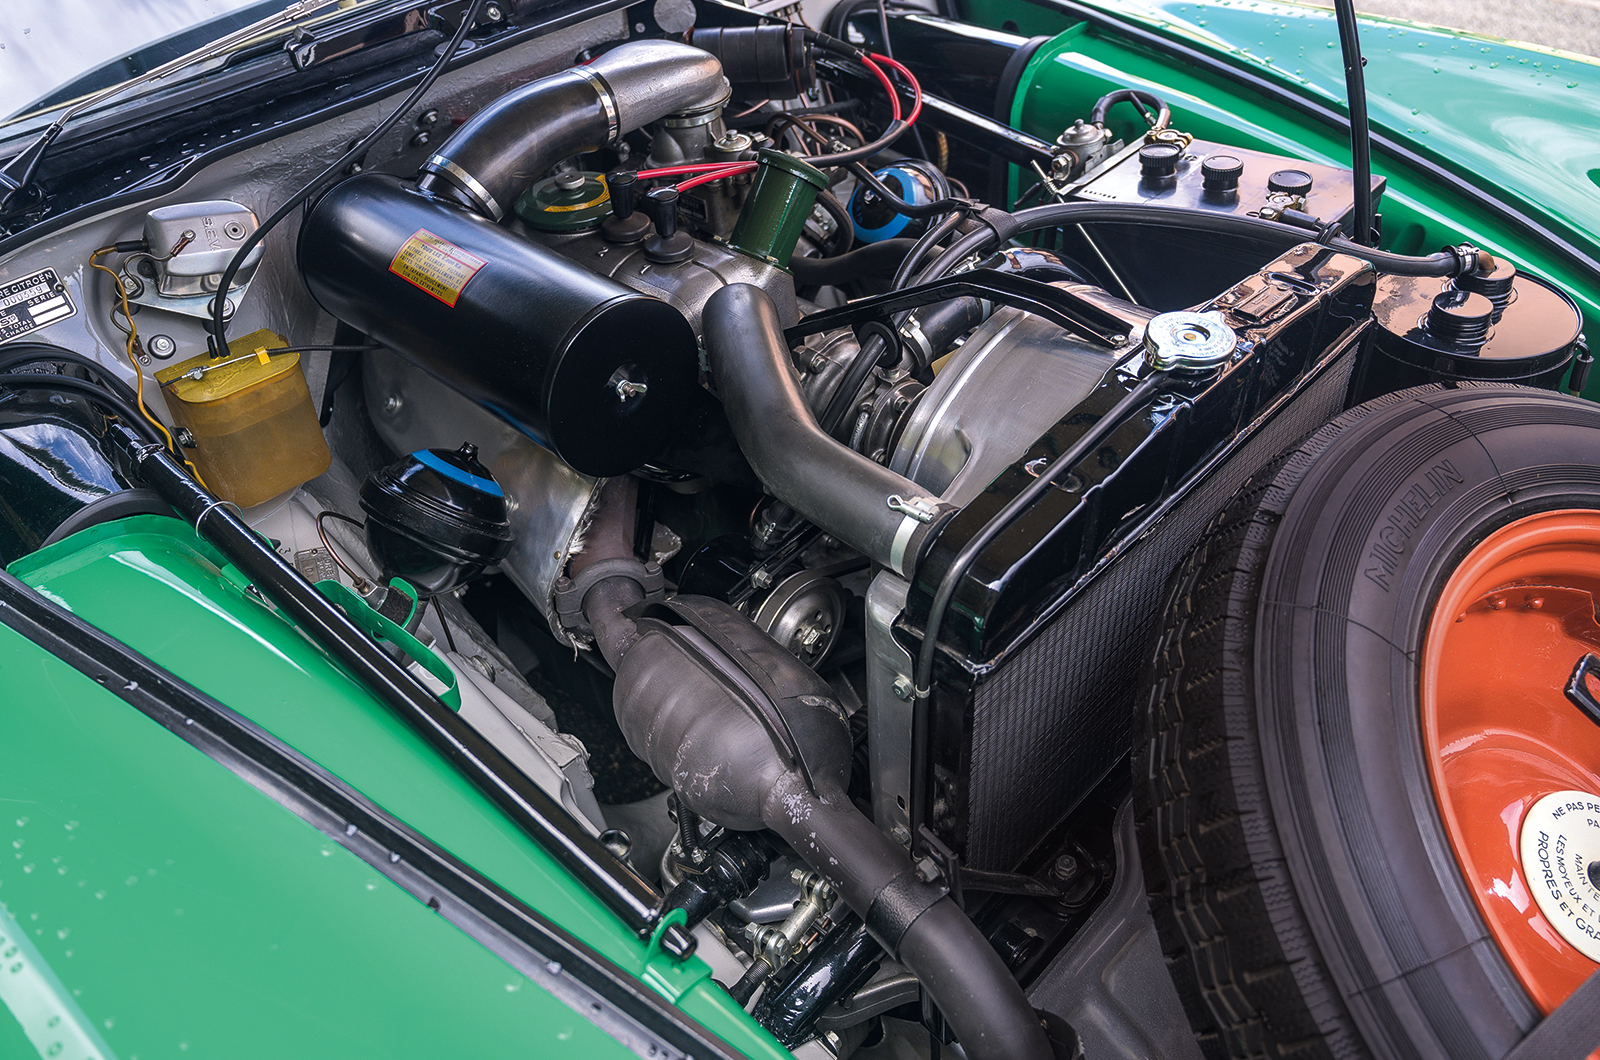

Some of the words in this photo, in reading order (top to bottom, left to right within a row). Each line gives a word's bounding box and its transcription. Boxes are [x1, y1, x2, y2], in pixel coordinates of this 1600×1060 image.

[11, 272, 53, 293] CITROËN
[27, 291, 56, 306] SERIE
[5, 324, 35, 338] CHARGE
[10, 318, 32, 330] TOTAL
[1364, 458, 1464, 592] MICHELIN
[1551, 806, 1566, 820] NE
[1565, 801, 1584, 812] PAS
[1555, 834, 1567, 855] LES
[1537, 830, 1562, 900] PROPRES
[1559, 901, 1574, 917] ET
[1556, 854, 1582, 903] MOYEUX
[1581, 902, 1596, 916] ET
